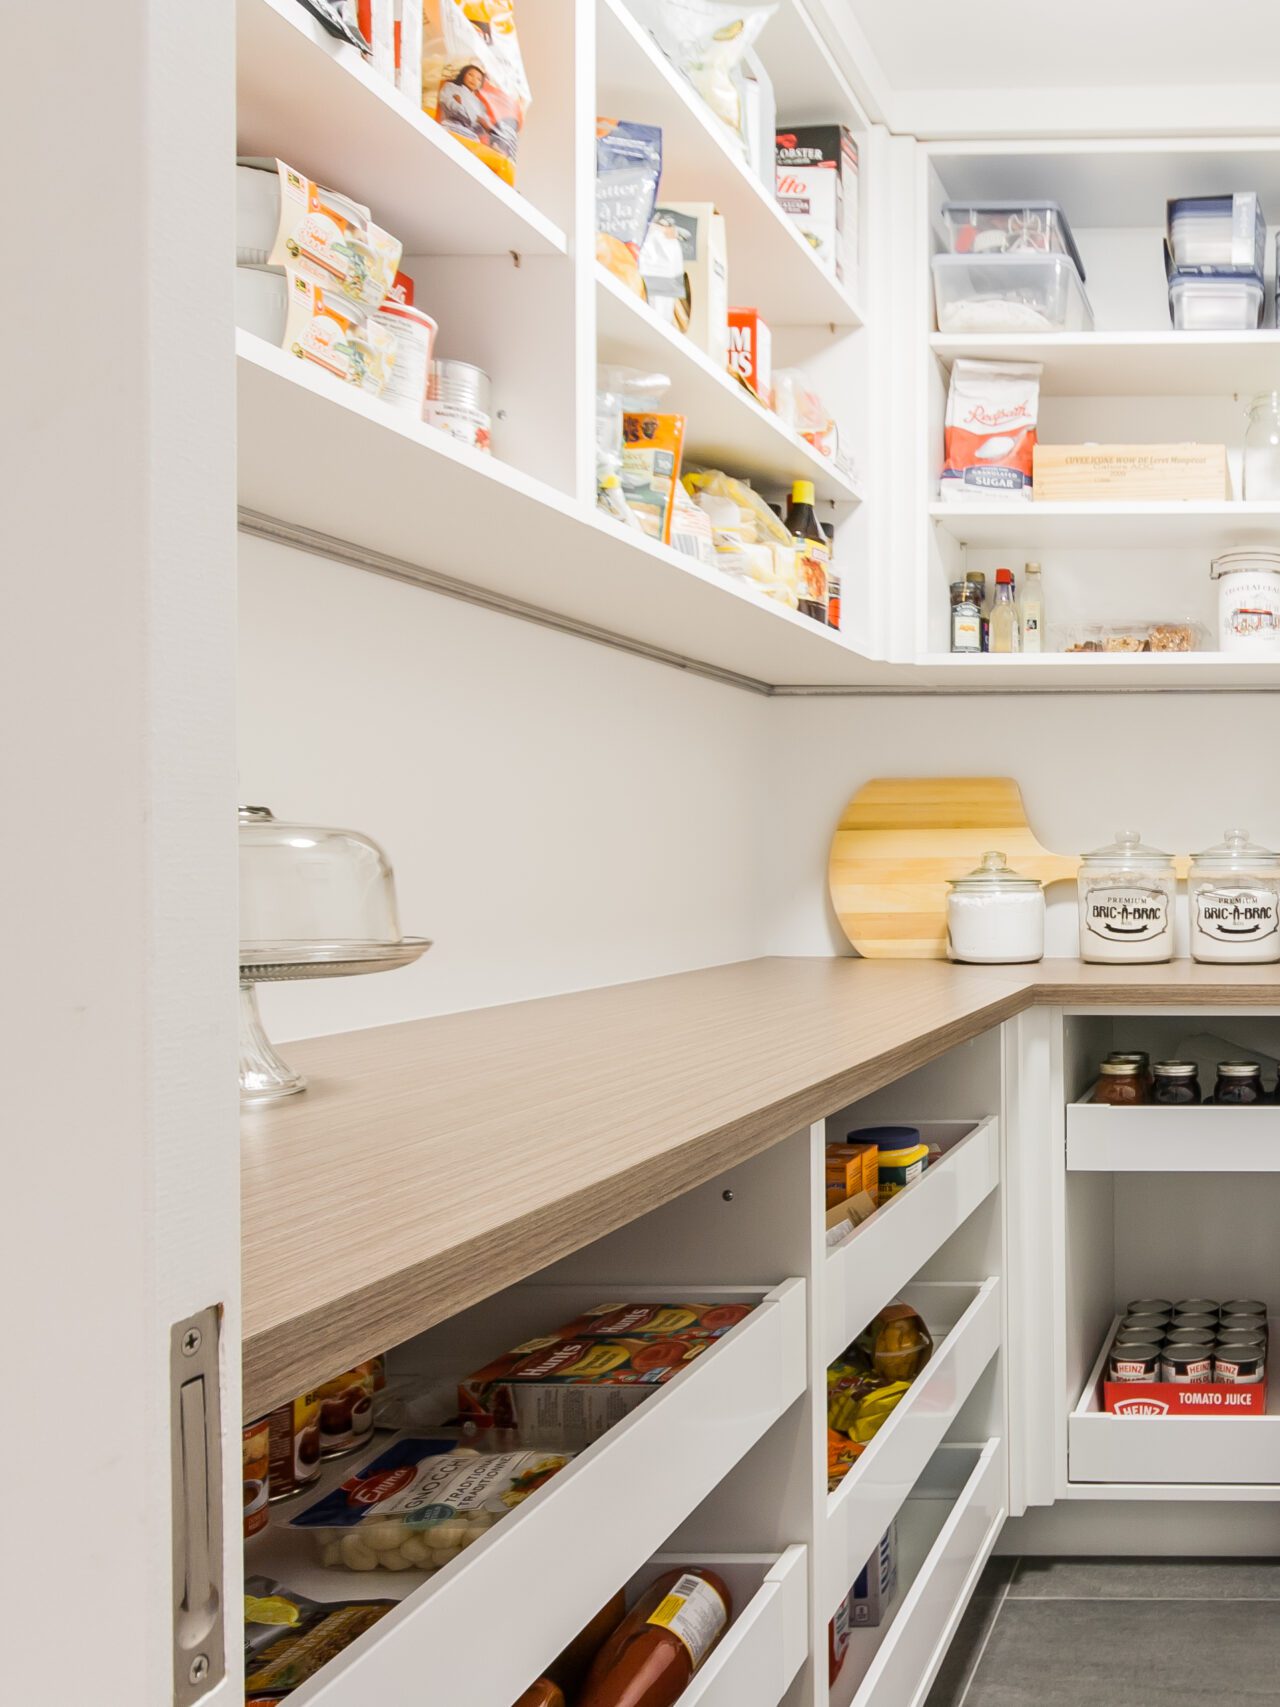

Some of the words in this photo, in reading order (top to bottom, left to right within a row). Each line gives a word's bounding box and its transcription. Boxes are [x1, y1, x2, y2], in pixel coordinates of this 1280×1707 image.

[777, 147, 823, 161] OBSTER
[596, 183, 639, 199] atter
[976, 478, 1014, 488] SUGAR
[1107, 896, 1148, 905] PREMIUM
[1218, 896, 1258, 905] PREMIUM
[1092, 904, 1161, 920] BRIC-À-BRAC
[1204, 904, 1272, 920] BRIC-À-BRAC
[1118, 1364, 1143, 1374] HEINZ
[1189, 1362, 1210, 1375] HEIN
[1178, 1392, 1222, 1405] TOMATO
[1224, 1393, 1252, 1406] JUICE
[1122, 1404, 1160, 1416] HEINZ
[404, 1458, 468, 1510] GNOCCHI
